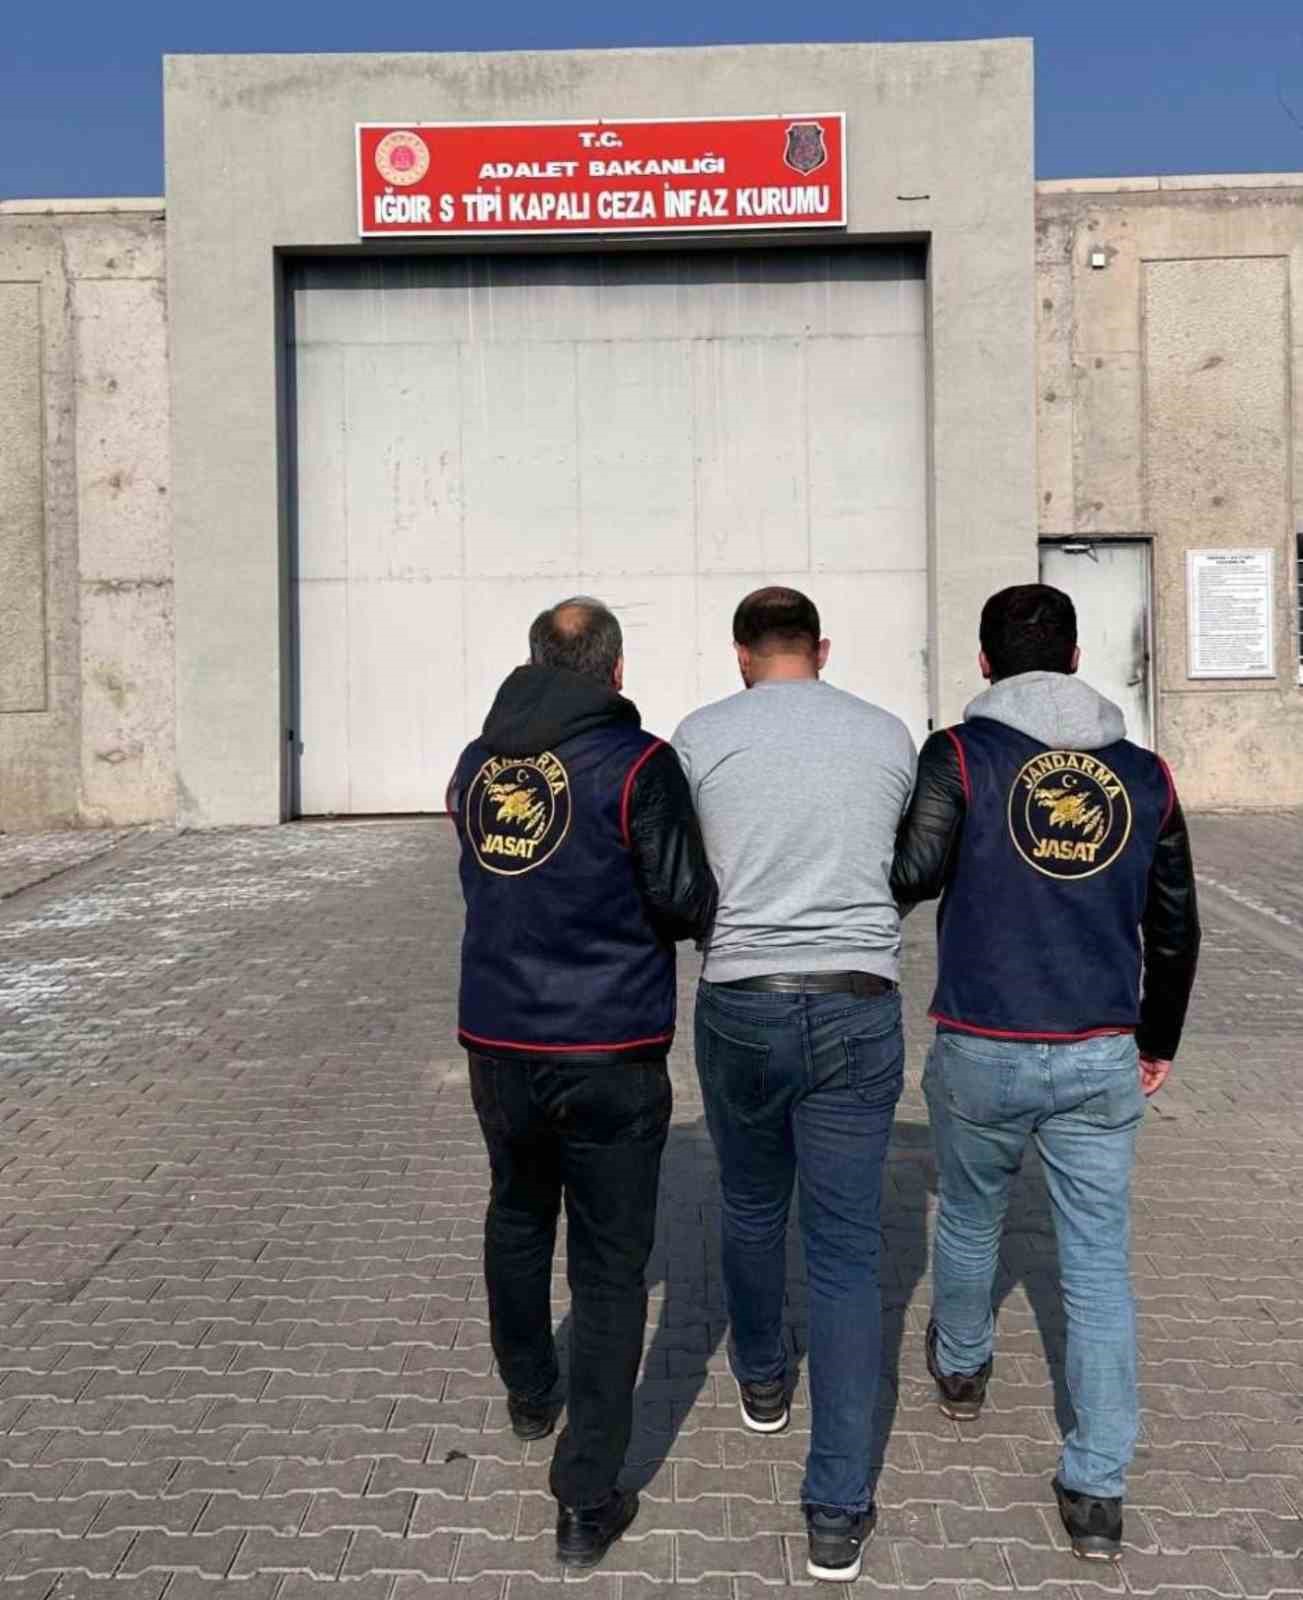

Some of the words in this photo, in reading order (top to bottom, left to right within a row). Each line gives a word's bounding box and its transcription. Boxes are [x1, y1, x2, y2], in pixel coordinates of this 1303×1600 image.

[578, 131, 623, 148] T.C.
[478, 161, 579, 179] ADALET
[589, 152, 725, 176] BAKANLIĞI
[374, 186, 432, 224] IĞDIR
[439, 194, 454, 222] S
[462, 186, 502, 222] TİPİ
[509, 192, 590, 222] KAPALI
[597, 190, 656, 219] CEZA
[664, 181, 729, 218] İNFAZ
[736, 185, 829, 217] KURUMU
[1021, 754, 1121, 800] JANDARMA
[481, 834, 539, 859] JASAT
[1033, 838, 1100, 862] JASAT
